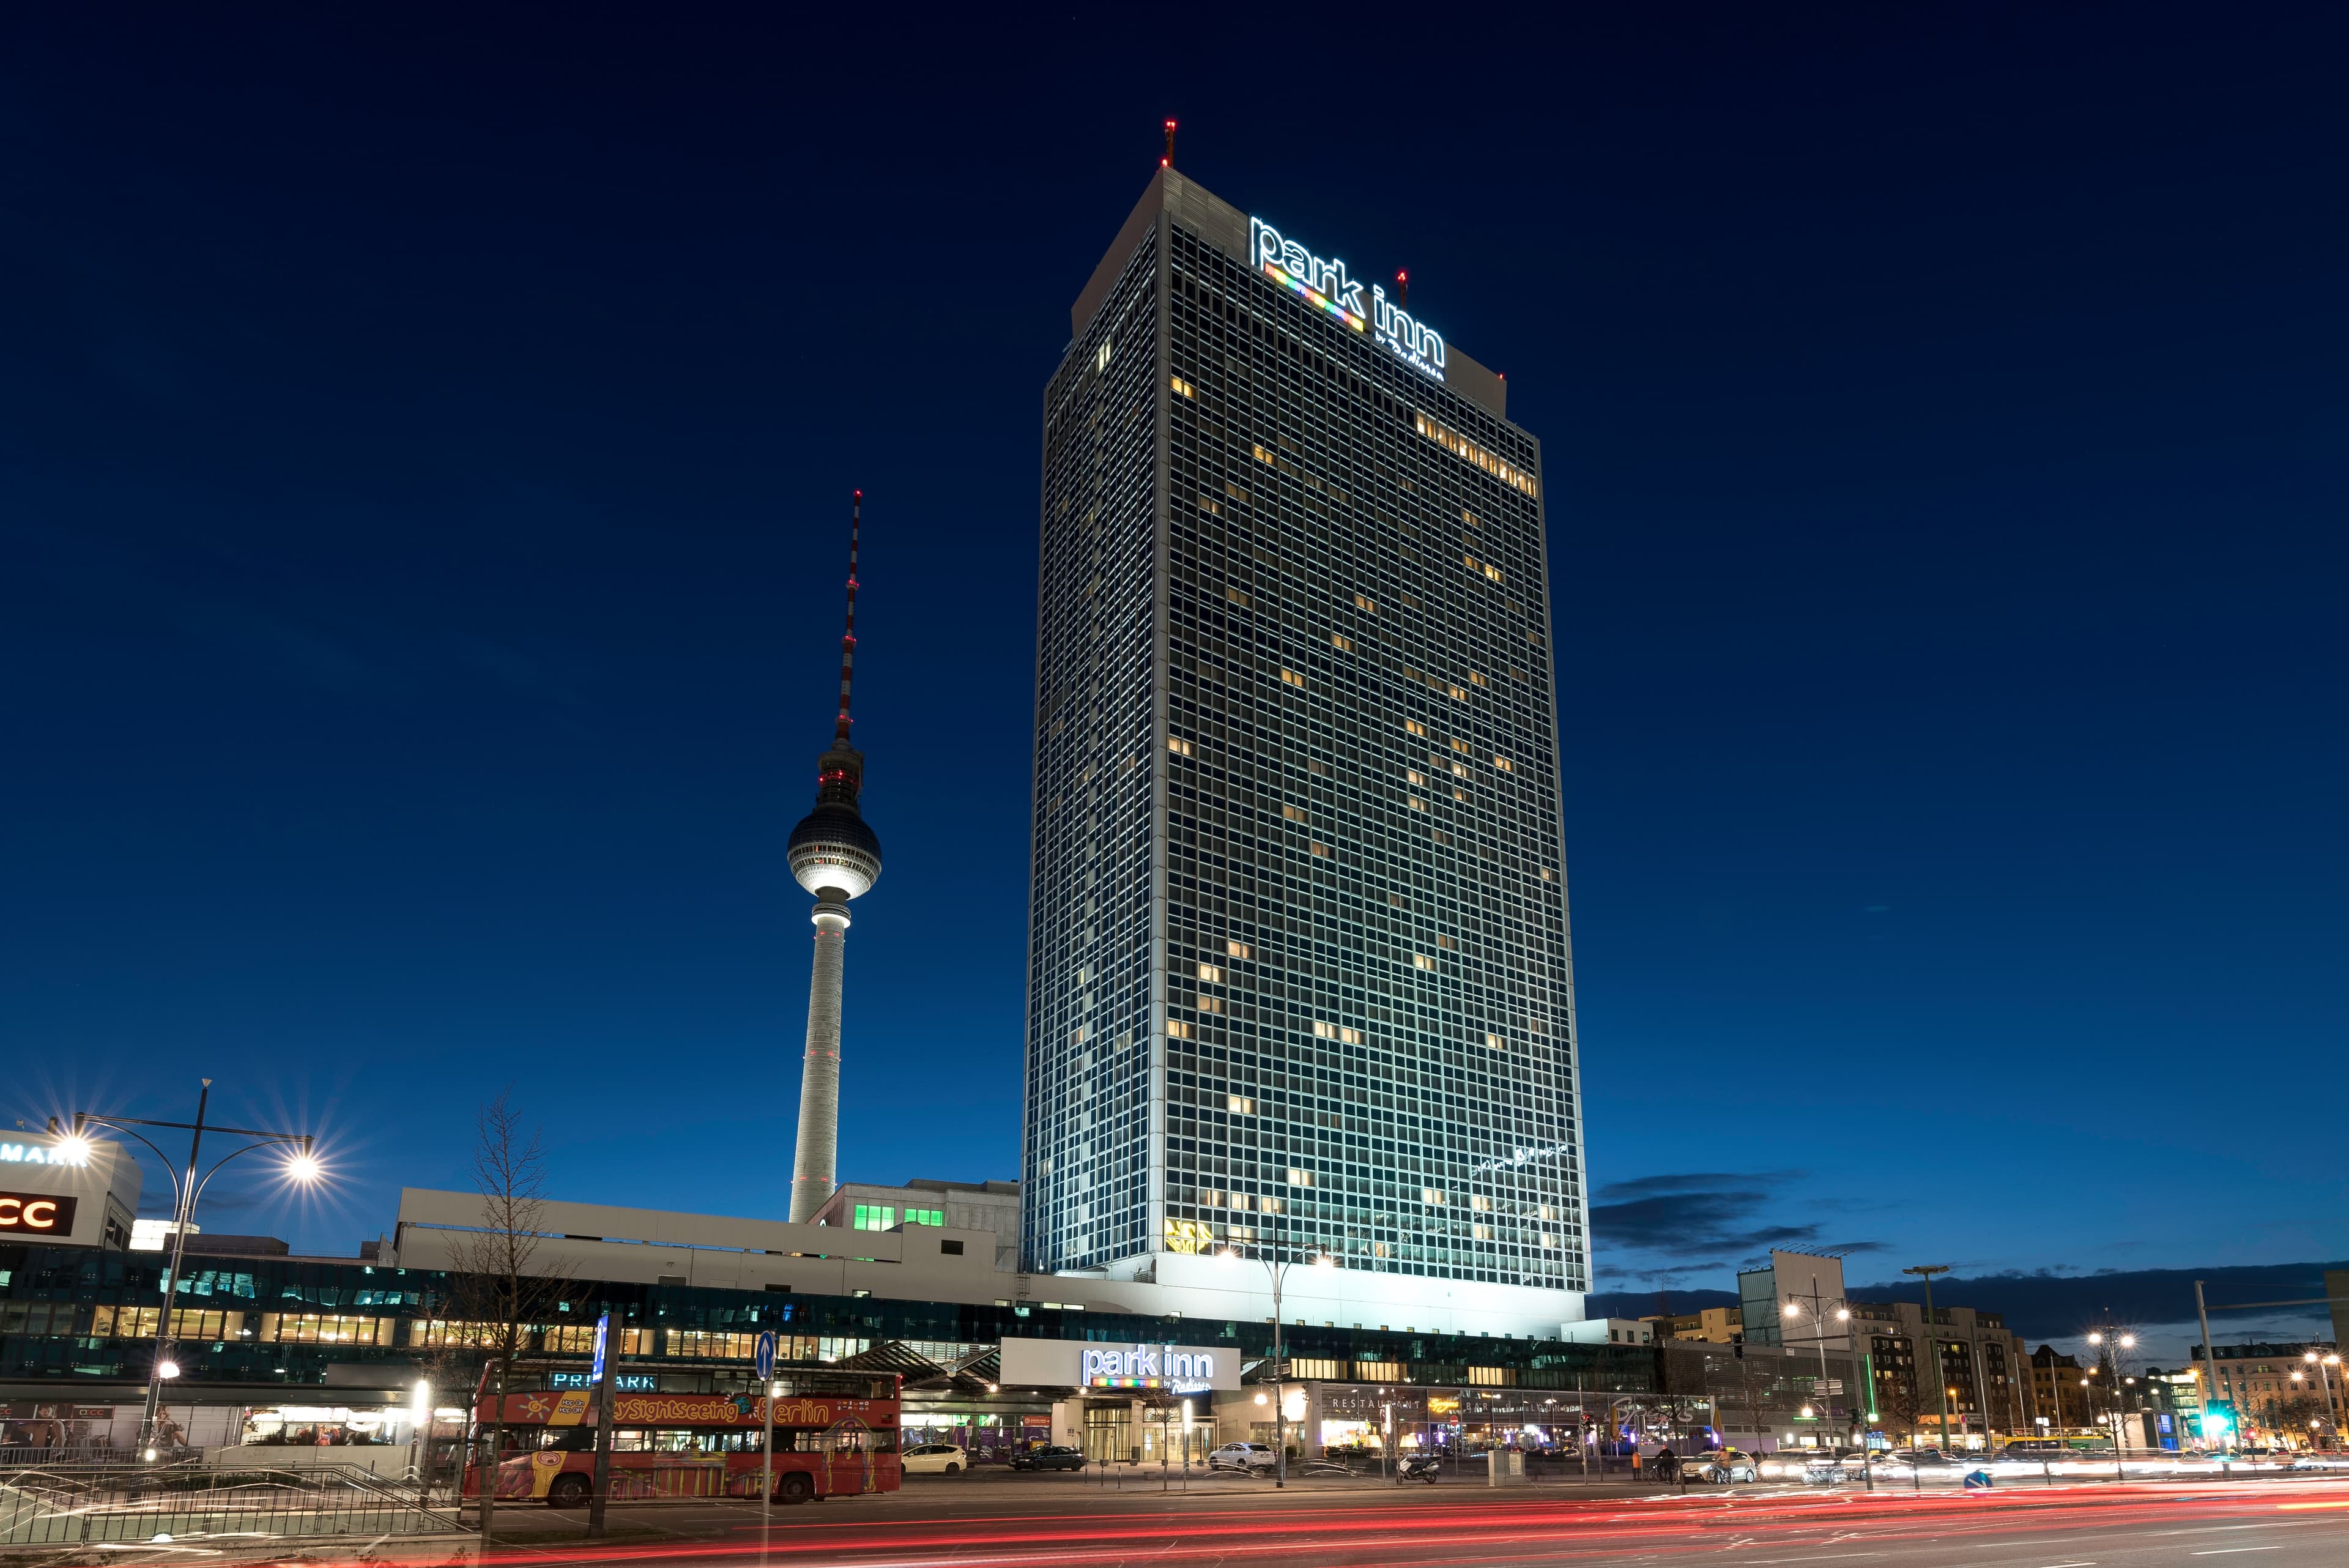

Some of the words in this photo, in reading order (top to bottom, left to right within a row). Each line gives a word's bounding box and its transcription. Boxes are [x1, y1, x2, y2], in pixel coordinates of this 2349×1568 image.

[1250, 215, 1367, 320] park
[1373, 283, 1445, 368] inn
[1375, 330, 1386, 344] by
[1082, 1343, 1159, 1386] park
[1163, 1345, 1214, 1378] inn
[554, 1373, 655, 1389] PRIARK
[1163, 1379, 1171, 1388] by
[1332, 1399, 1420, 1410] RESTAURANT
[1466, 1401, 1488, 1411] BAR
